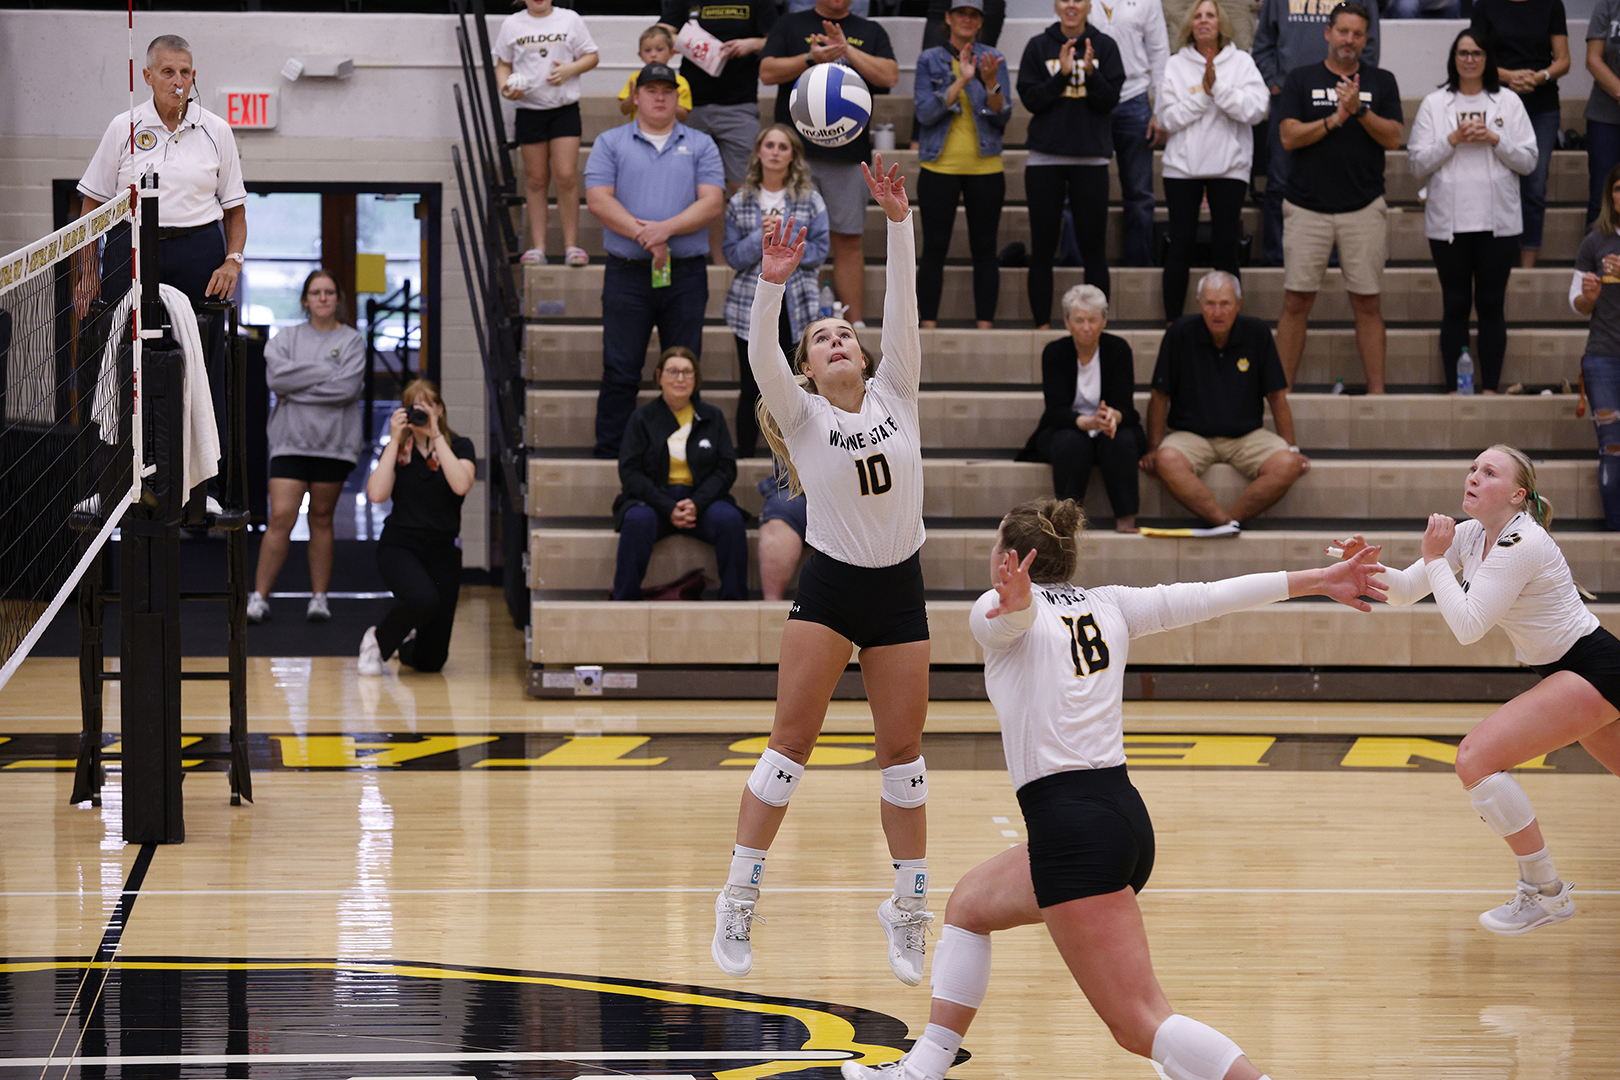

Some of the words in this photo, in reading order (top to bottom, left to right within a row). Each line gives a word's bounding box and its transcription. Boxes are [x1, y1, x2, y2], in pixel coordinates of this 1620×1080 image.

[227, 93, 270, 126] EXIT
[801, 125, 845, 138] molten
[829, 429, 866, 451] WAYNE
[854, 452, 893, 497] 10
[1060, 611, 1110, 678] 18
